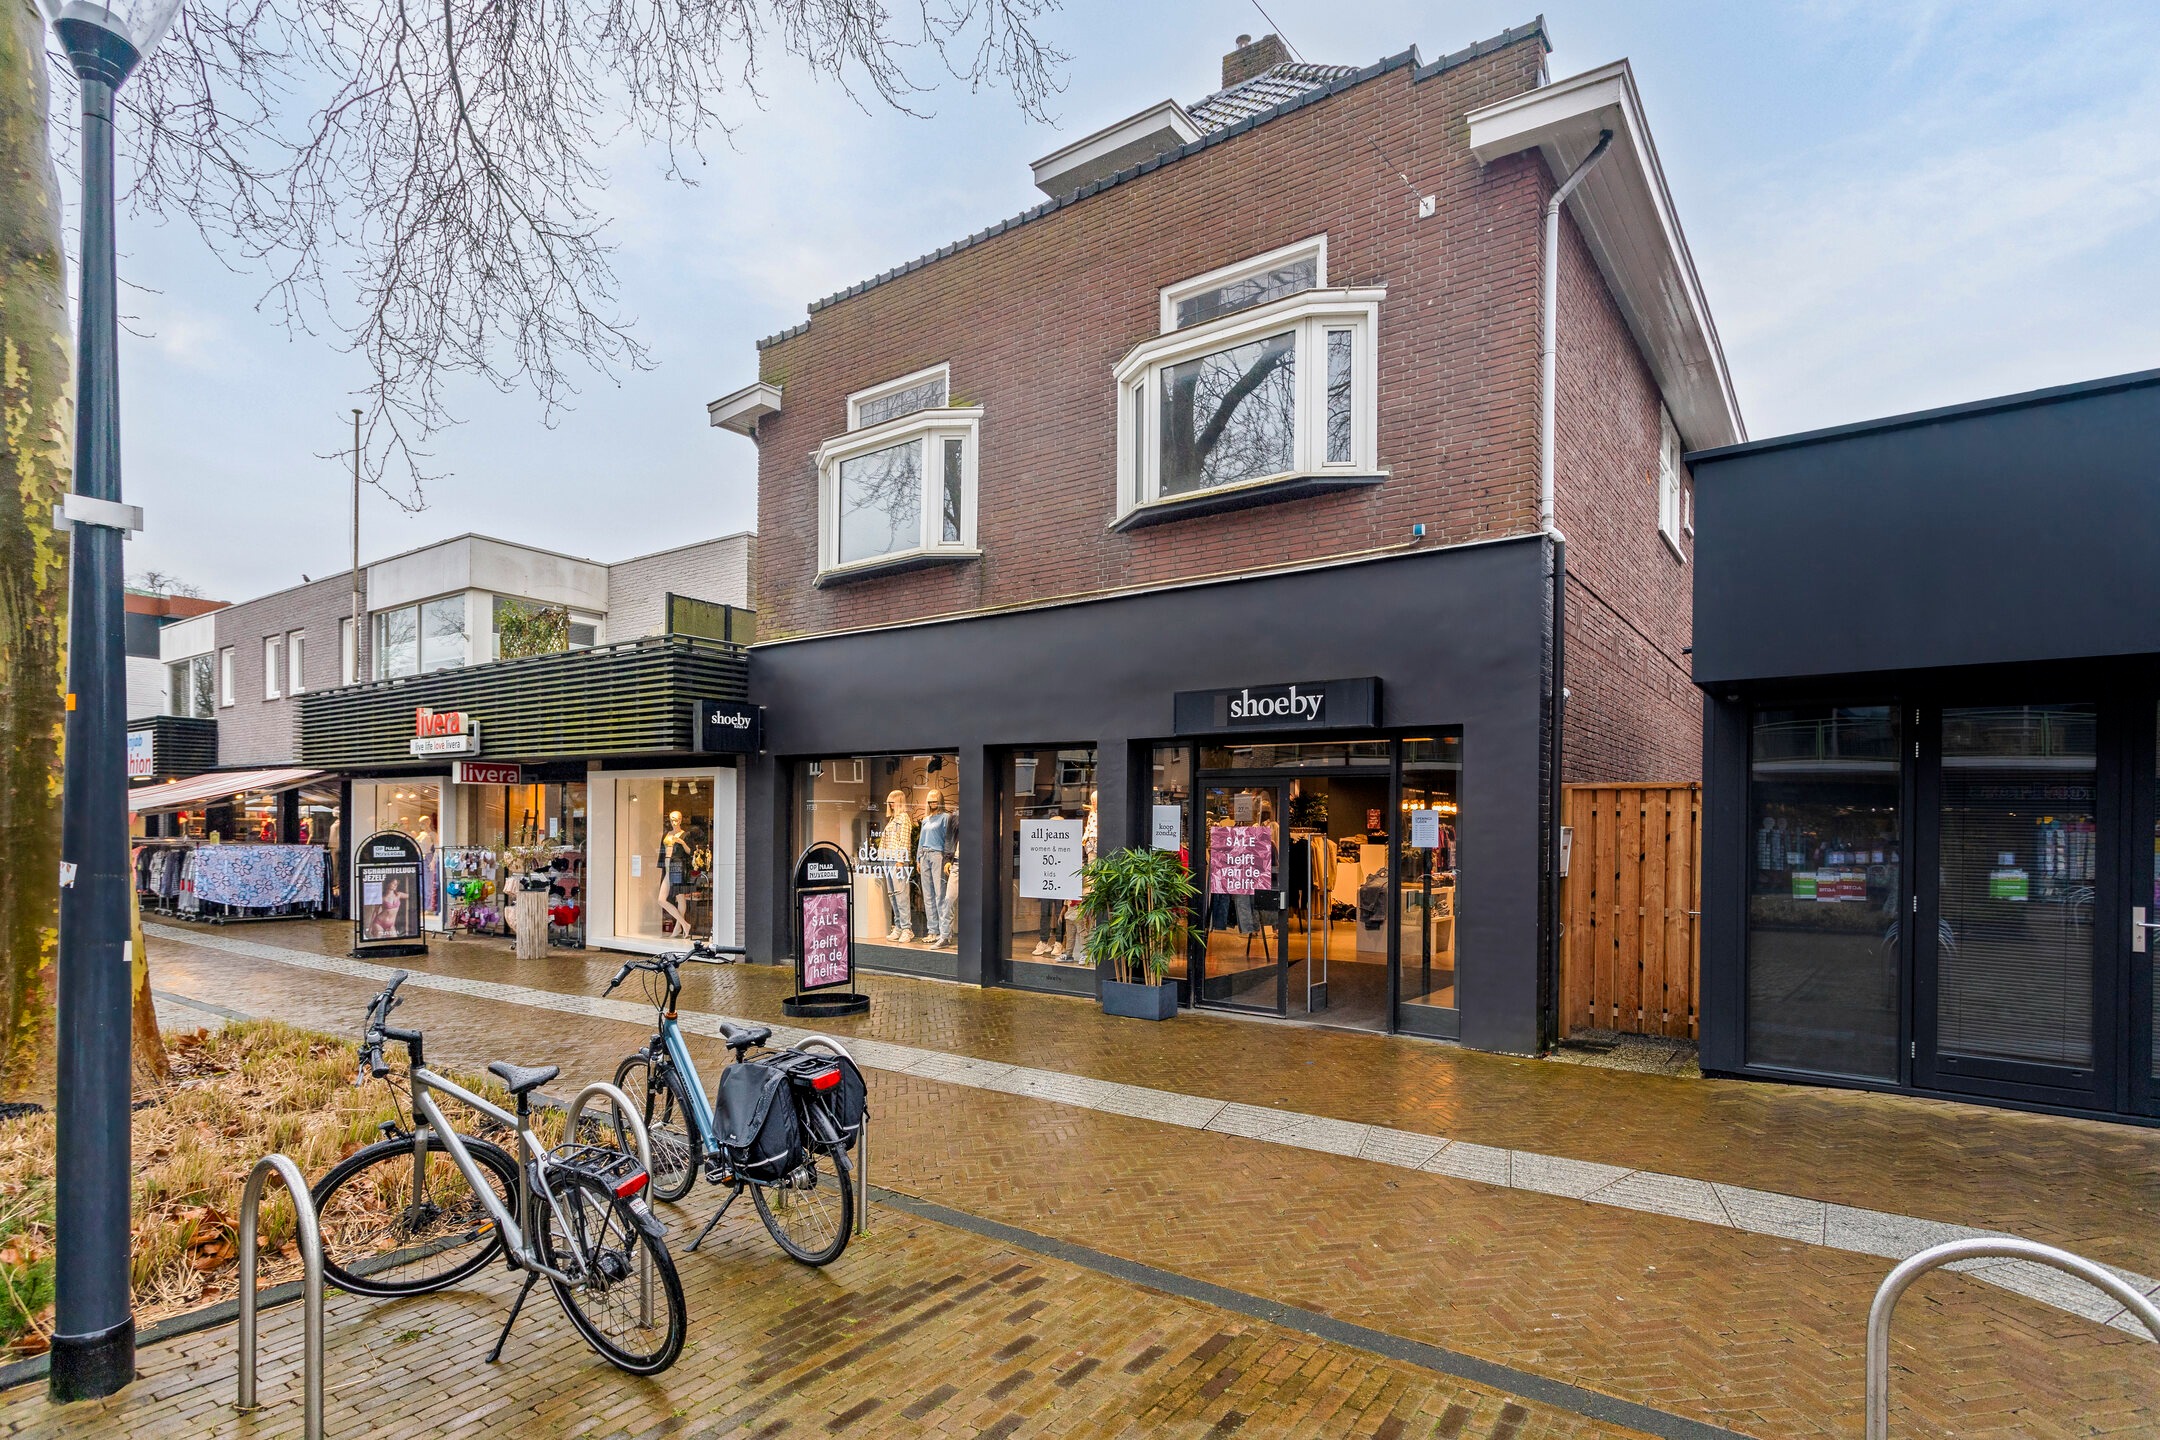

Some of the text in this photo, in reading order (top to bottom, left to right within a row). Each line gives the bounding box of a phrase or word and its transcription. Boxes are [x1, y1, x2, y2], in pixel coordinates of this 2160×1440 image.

[1230, 685, 1324, 721] shoeby
[416, 707, 460, 737] livera
[711, 710, 751, 730] shoeby
[415, 739, 461, 752] live life love livera
[463, 764, 518, 782] livera
[1158, 823, 1174, 832] koop
[1031, 828, 1071, 842] all jeans
[1225, 836, 1256, 847] SALE
[1042, 854, 1062, 866] 50.-
[1226, 853, 1255, 866] helft
[363, 867, 416, 875] SCHAAMTELOOS
[818, 863, 834, 871] NAAR
[1221, 865, 1261, 878] van de
[855, 864, 914, 884] runway
[1042, 879, 1062, 891] 25.-
[1226, 878, 1255, 890] helft
[812, 913, 839, 927] SALE
[812, 934, 838, 949] helft
[807, 947, 843, 965] van de
[812, 966, 838, 979] helft
